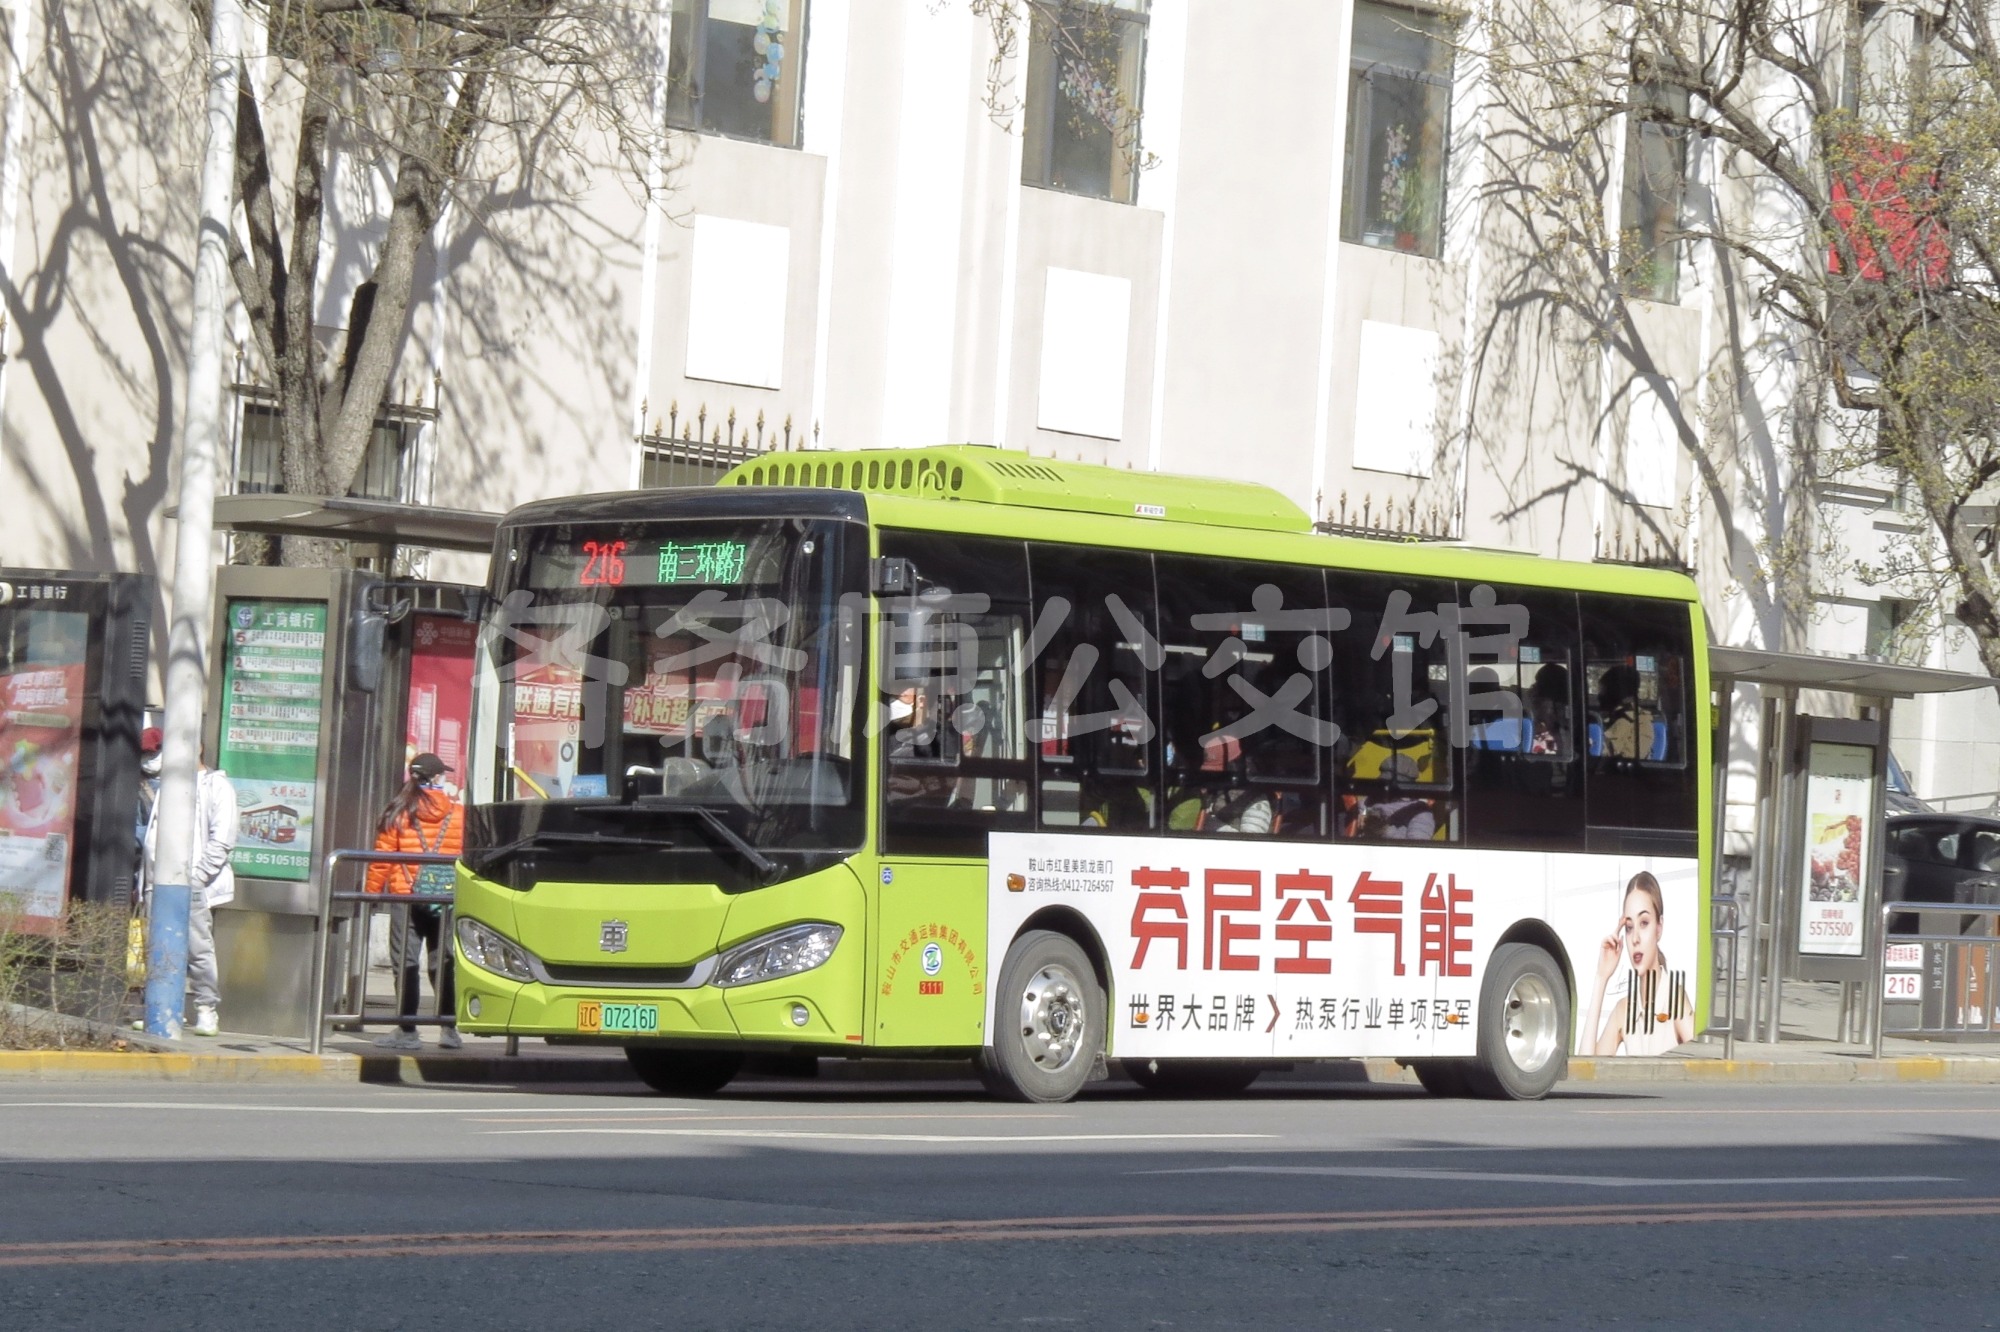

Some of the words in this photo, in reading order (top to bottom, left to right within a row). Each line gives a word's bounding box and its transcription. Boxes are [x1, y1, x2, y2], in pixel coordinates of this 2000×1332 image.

[580, 541, 626, 585] 216
[17, 586, 68, 599] 工商银行
[262, 611, 316, 629] 工商银行
[255, 853, 310, 867] 95105188
[1028, 858, 1113, 874] 鞍山市红星美凯龙南门
[1028, 877, 1114, 892] 咨询热线:0412-7264567
[1130, 866, 1473, 977] 芬尼空气能
[1809, 921, 1854, 937] 5575500
[881, 922, 982, 996] 鞍山市交通运输集团有限公司
[920, 981, 943, 993] 3111
[1888, 976, 1916, 994] 216
[1128, 993, 1256, 1032] 世界大品牌
[1296, 995, 1472, 1031] 热泵行业单项冠军
